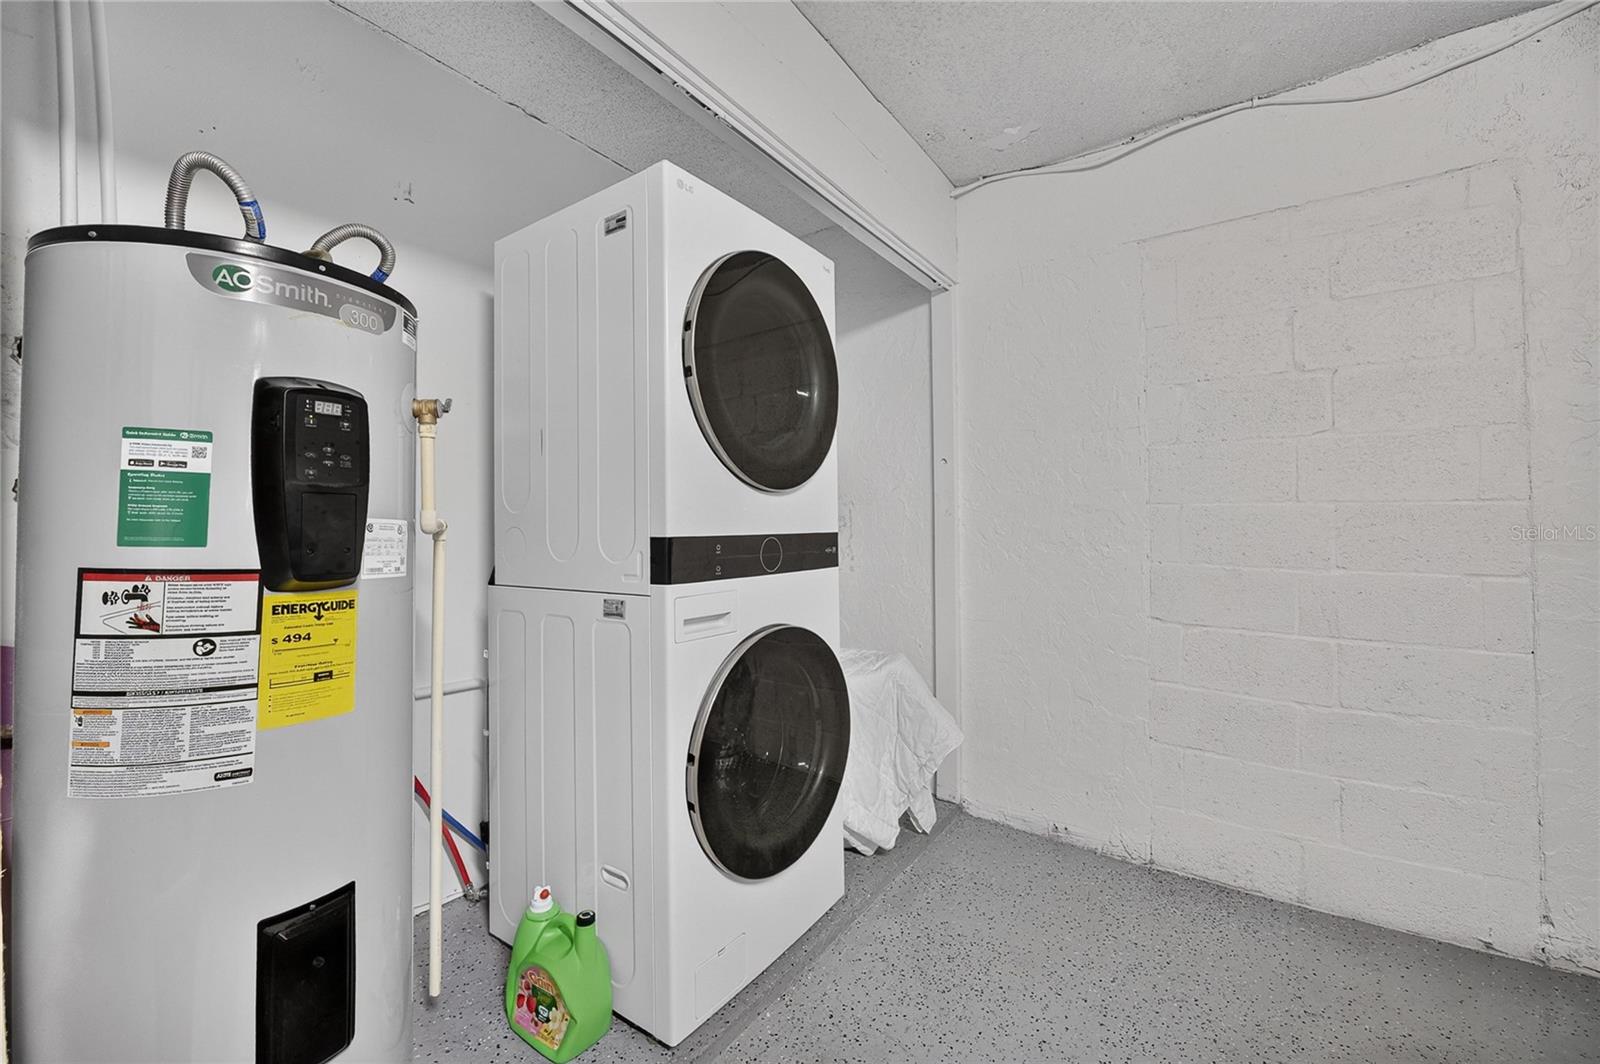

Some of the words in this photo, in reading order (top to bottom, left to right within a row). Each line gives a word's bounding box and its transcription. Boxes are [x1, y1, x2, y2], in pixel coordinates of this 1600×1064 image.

[350, 309, 378, 331] 300
[271, 599, 355, 616] ENERGYGUIDE
[281, 632, 311, 644] 494
